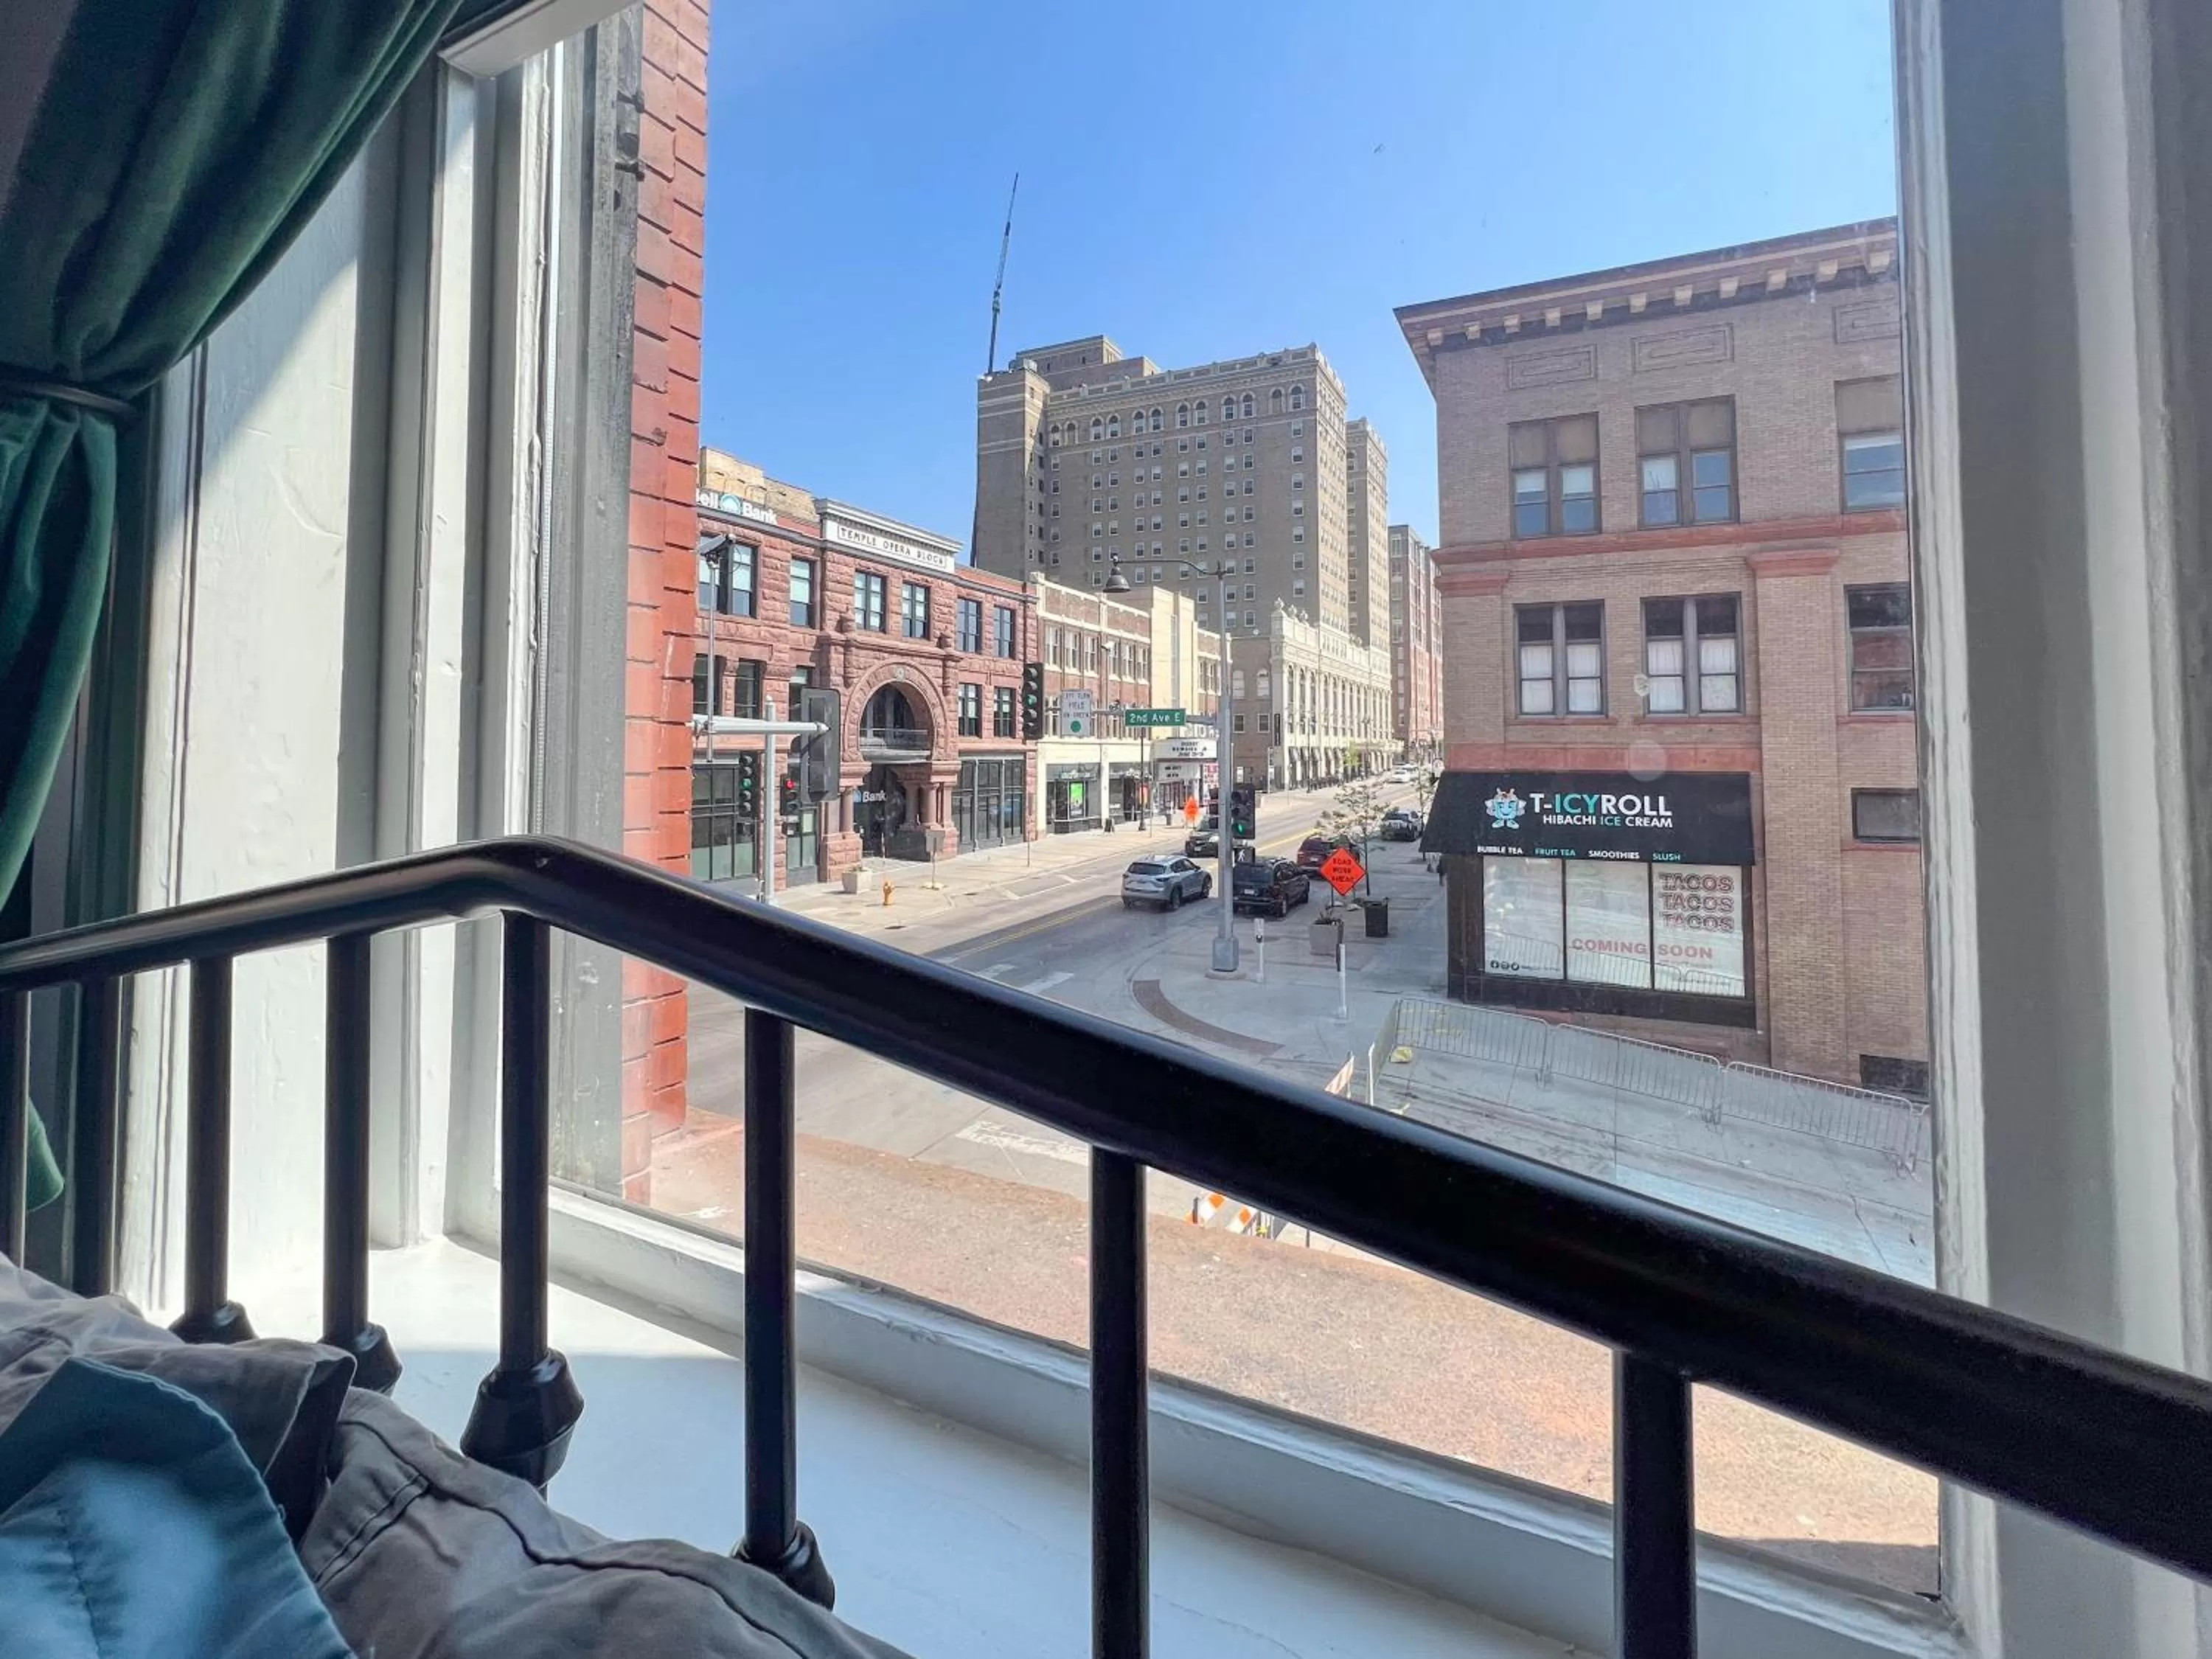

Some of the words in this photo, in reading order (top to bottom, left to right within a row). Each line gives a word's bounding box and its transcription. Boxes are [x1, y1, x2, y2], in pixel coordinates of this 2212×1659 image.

[742, 501, 779, 526] Bank
[841, 527, 876, 546] TEMPLE
[883, 540, 911, 555] OPERA
[917, 552, 943, 565] BLOCK
[1129, 713, 1148, 723] 2nd
[1152, 713, 1170, 723] Ave
[1175, 712, 1180, 722] E
[863, 790, 886, 802] Bank
[1529, 793, 1672, 816] T-ICYROLL
[1543, 815, 1596, 825] HIBACHI
[1601, 816, 1621, 827] ICE
[1625, 816, 1673, 828] CREAM
[1477, 845, 1506, 854] BUBBLE
[1587, 850, 1640, 859] SMOOTHIES
[1652, 852, 1680, 860] SLUSH
[1659, 872, 1734, 893] TACOS
[1660, 892, 1734, 913] TACOS
[1661, 911, 1735, 933] TACOS
[1572, 938, 1647, 955] COMING
[1659, 945, 1712, 959] SOON
